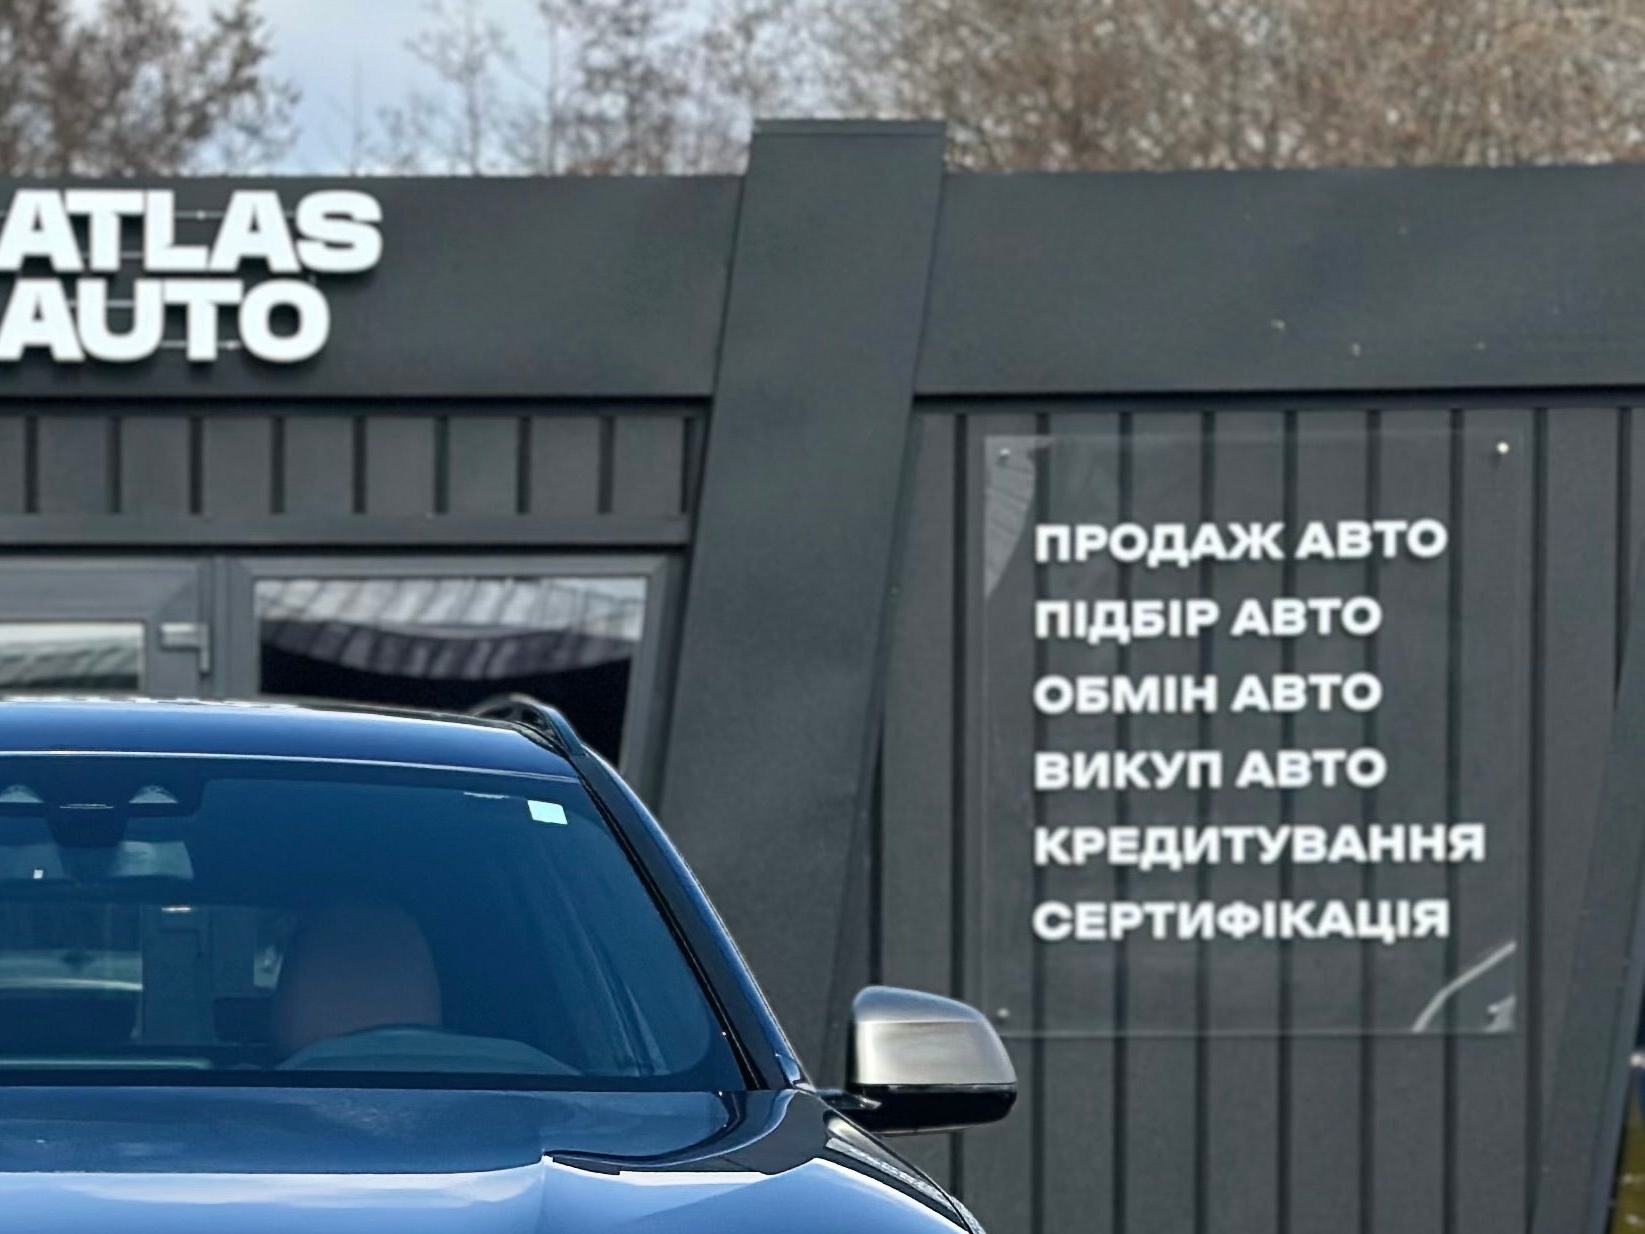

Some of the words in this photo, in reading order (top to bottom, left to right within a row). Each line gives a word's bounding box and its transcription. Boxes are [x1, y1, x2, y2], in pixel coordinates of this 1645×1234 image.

[1035, 521, 1284, 568] ПРОДАЖ
[1295, 518, 1448, 559] АВТО
[1035, 599, 1220, 645] ПІДБІР
[1230, 596, 1383, 636] АВТО
[1033, 674, 1218, 714] ОБМІН
[1230, 672, 1383, 712] АВТО
[1034, 750, 1223, 790] ВИКУП
[1235, 748, 1387, 788] АВТО
[1034, 823, 1486, 871] КРЕДИТУВАННЯ
[1032, 898, 1449, 945] СЕРТИФІКАЦІЯ
